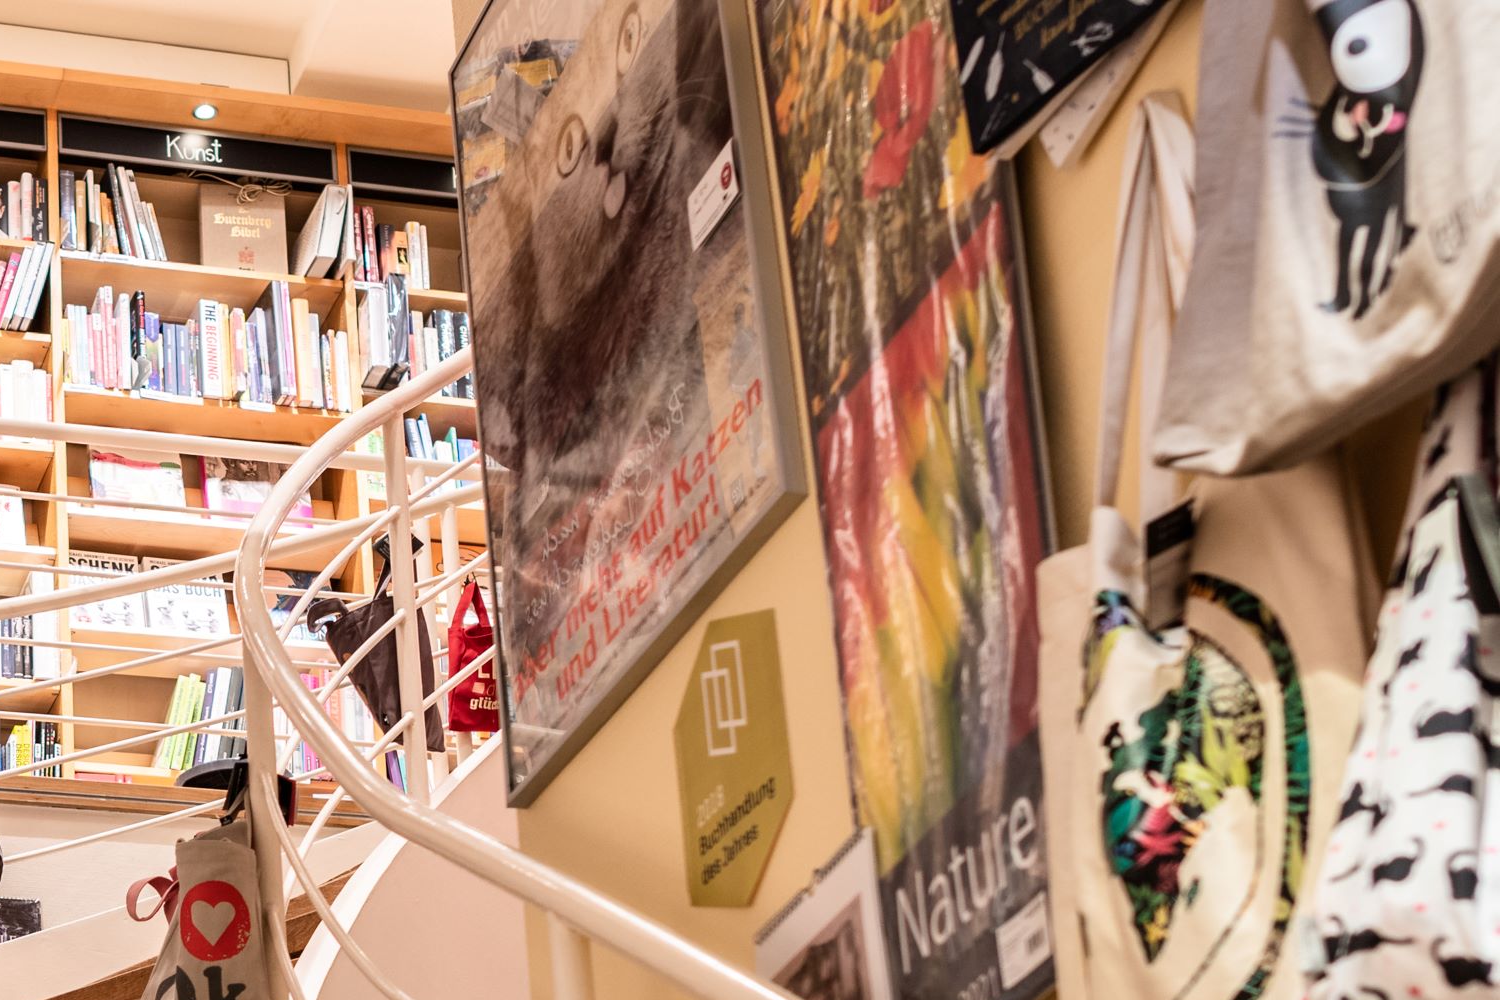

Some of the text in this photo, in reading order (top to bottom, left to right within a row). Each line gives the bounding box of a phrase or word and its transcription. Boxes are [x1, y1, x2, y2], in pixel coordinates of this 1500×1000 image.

[166, 135, 223, 163] Kunst
[205, 303, 219, 381] THE BEGINNING
[566, 547, 624, 643] nicht
[631, 486, 666, 562] auf
[669, 378, 764, 509] Katzen
[185, 586, 222, 598] BUCH
[555, 475, 722, 702] und Literatur!
[895, 796, 1036, 975] Nature
